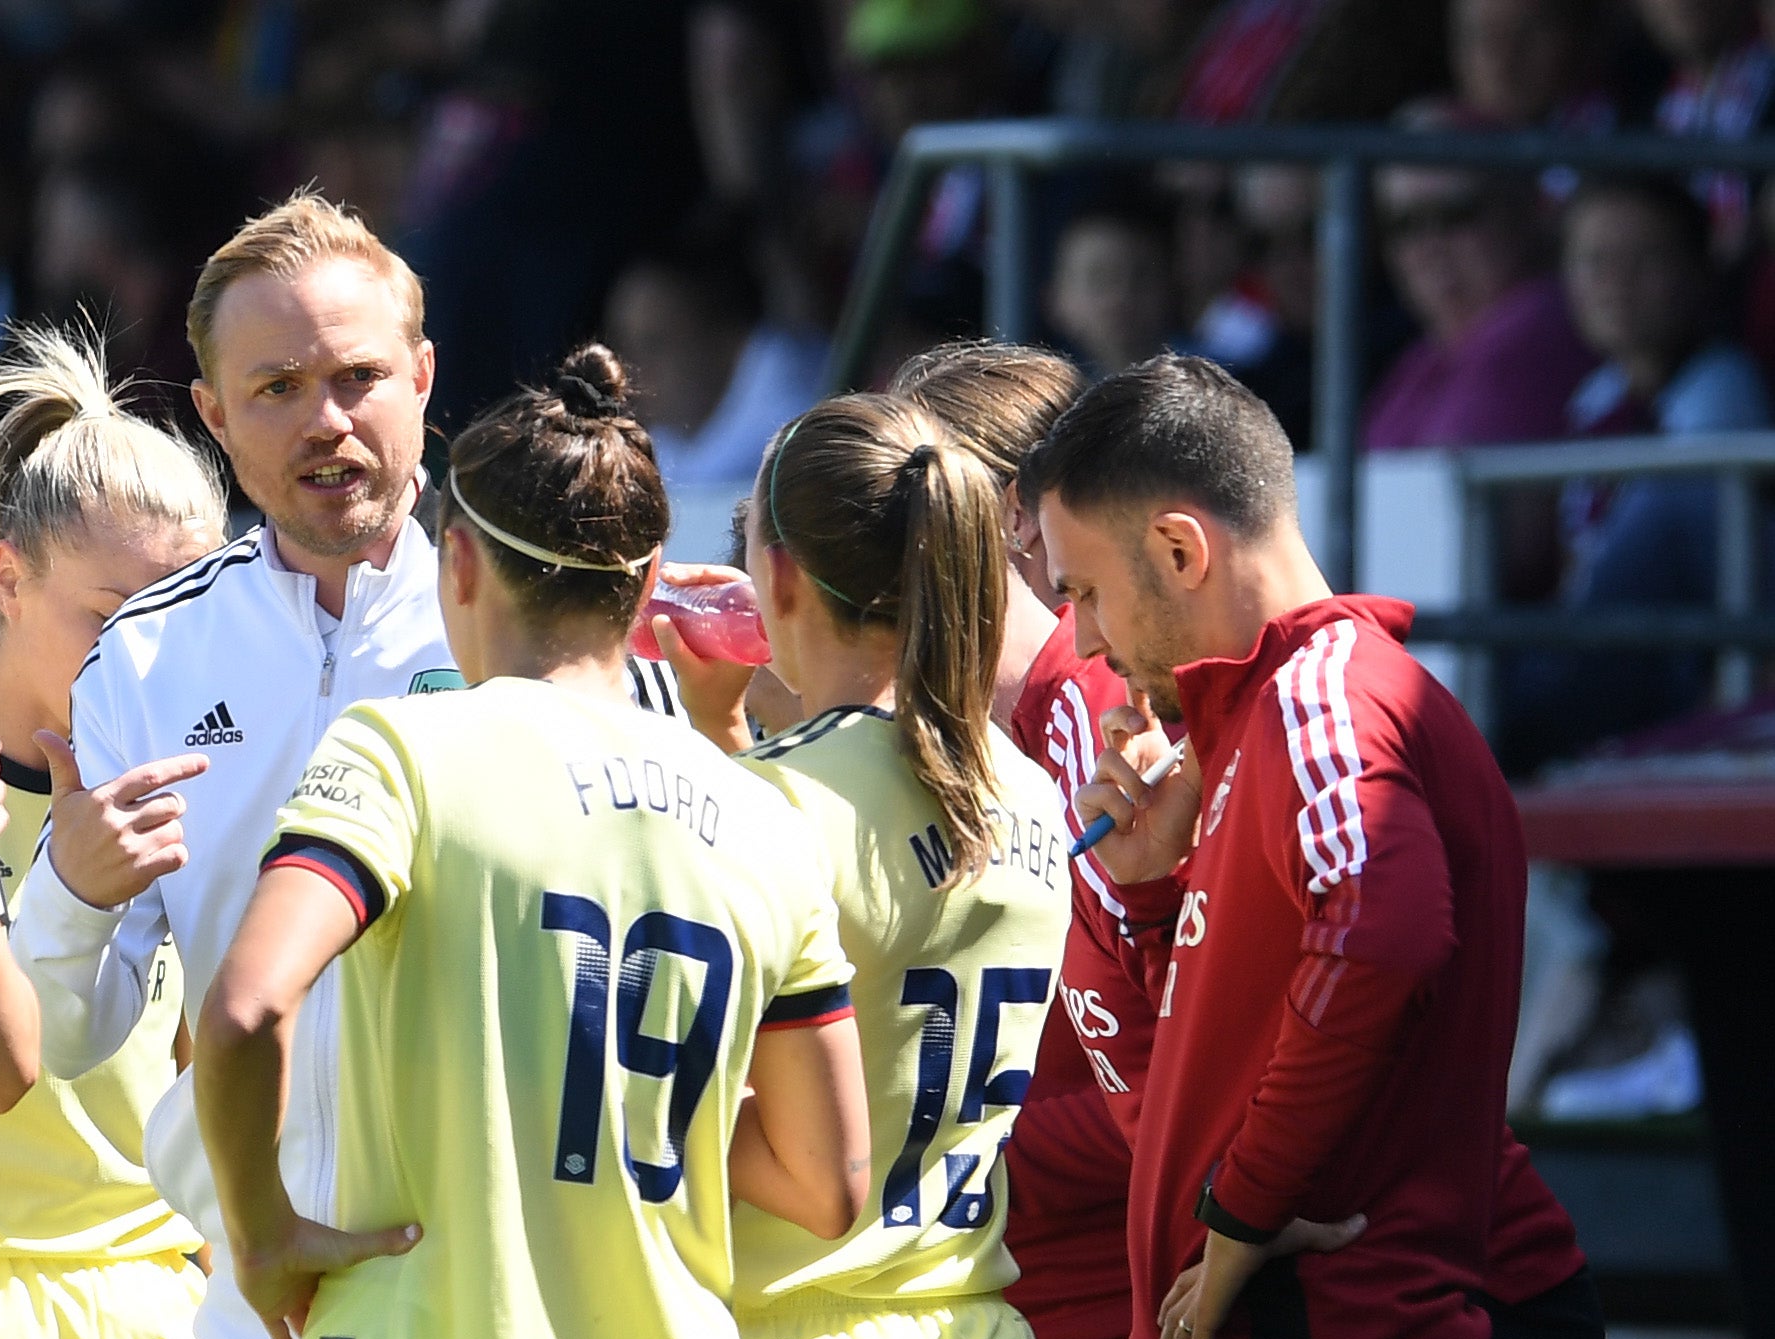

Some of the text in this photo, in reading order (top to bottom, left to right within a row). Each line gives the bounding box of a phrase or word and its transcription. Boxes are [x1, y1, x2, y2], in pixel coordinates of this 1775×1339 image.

[185, 728, 244, 746] adidas
[302, 764, 352, 782] VISIT
[567, 757, 720, 847] FOORD
[909, 808, 1060, 891] MCABE
[539, 890, 734, 1205] 19
[880, 966, 1053, 1229] 15
